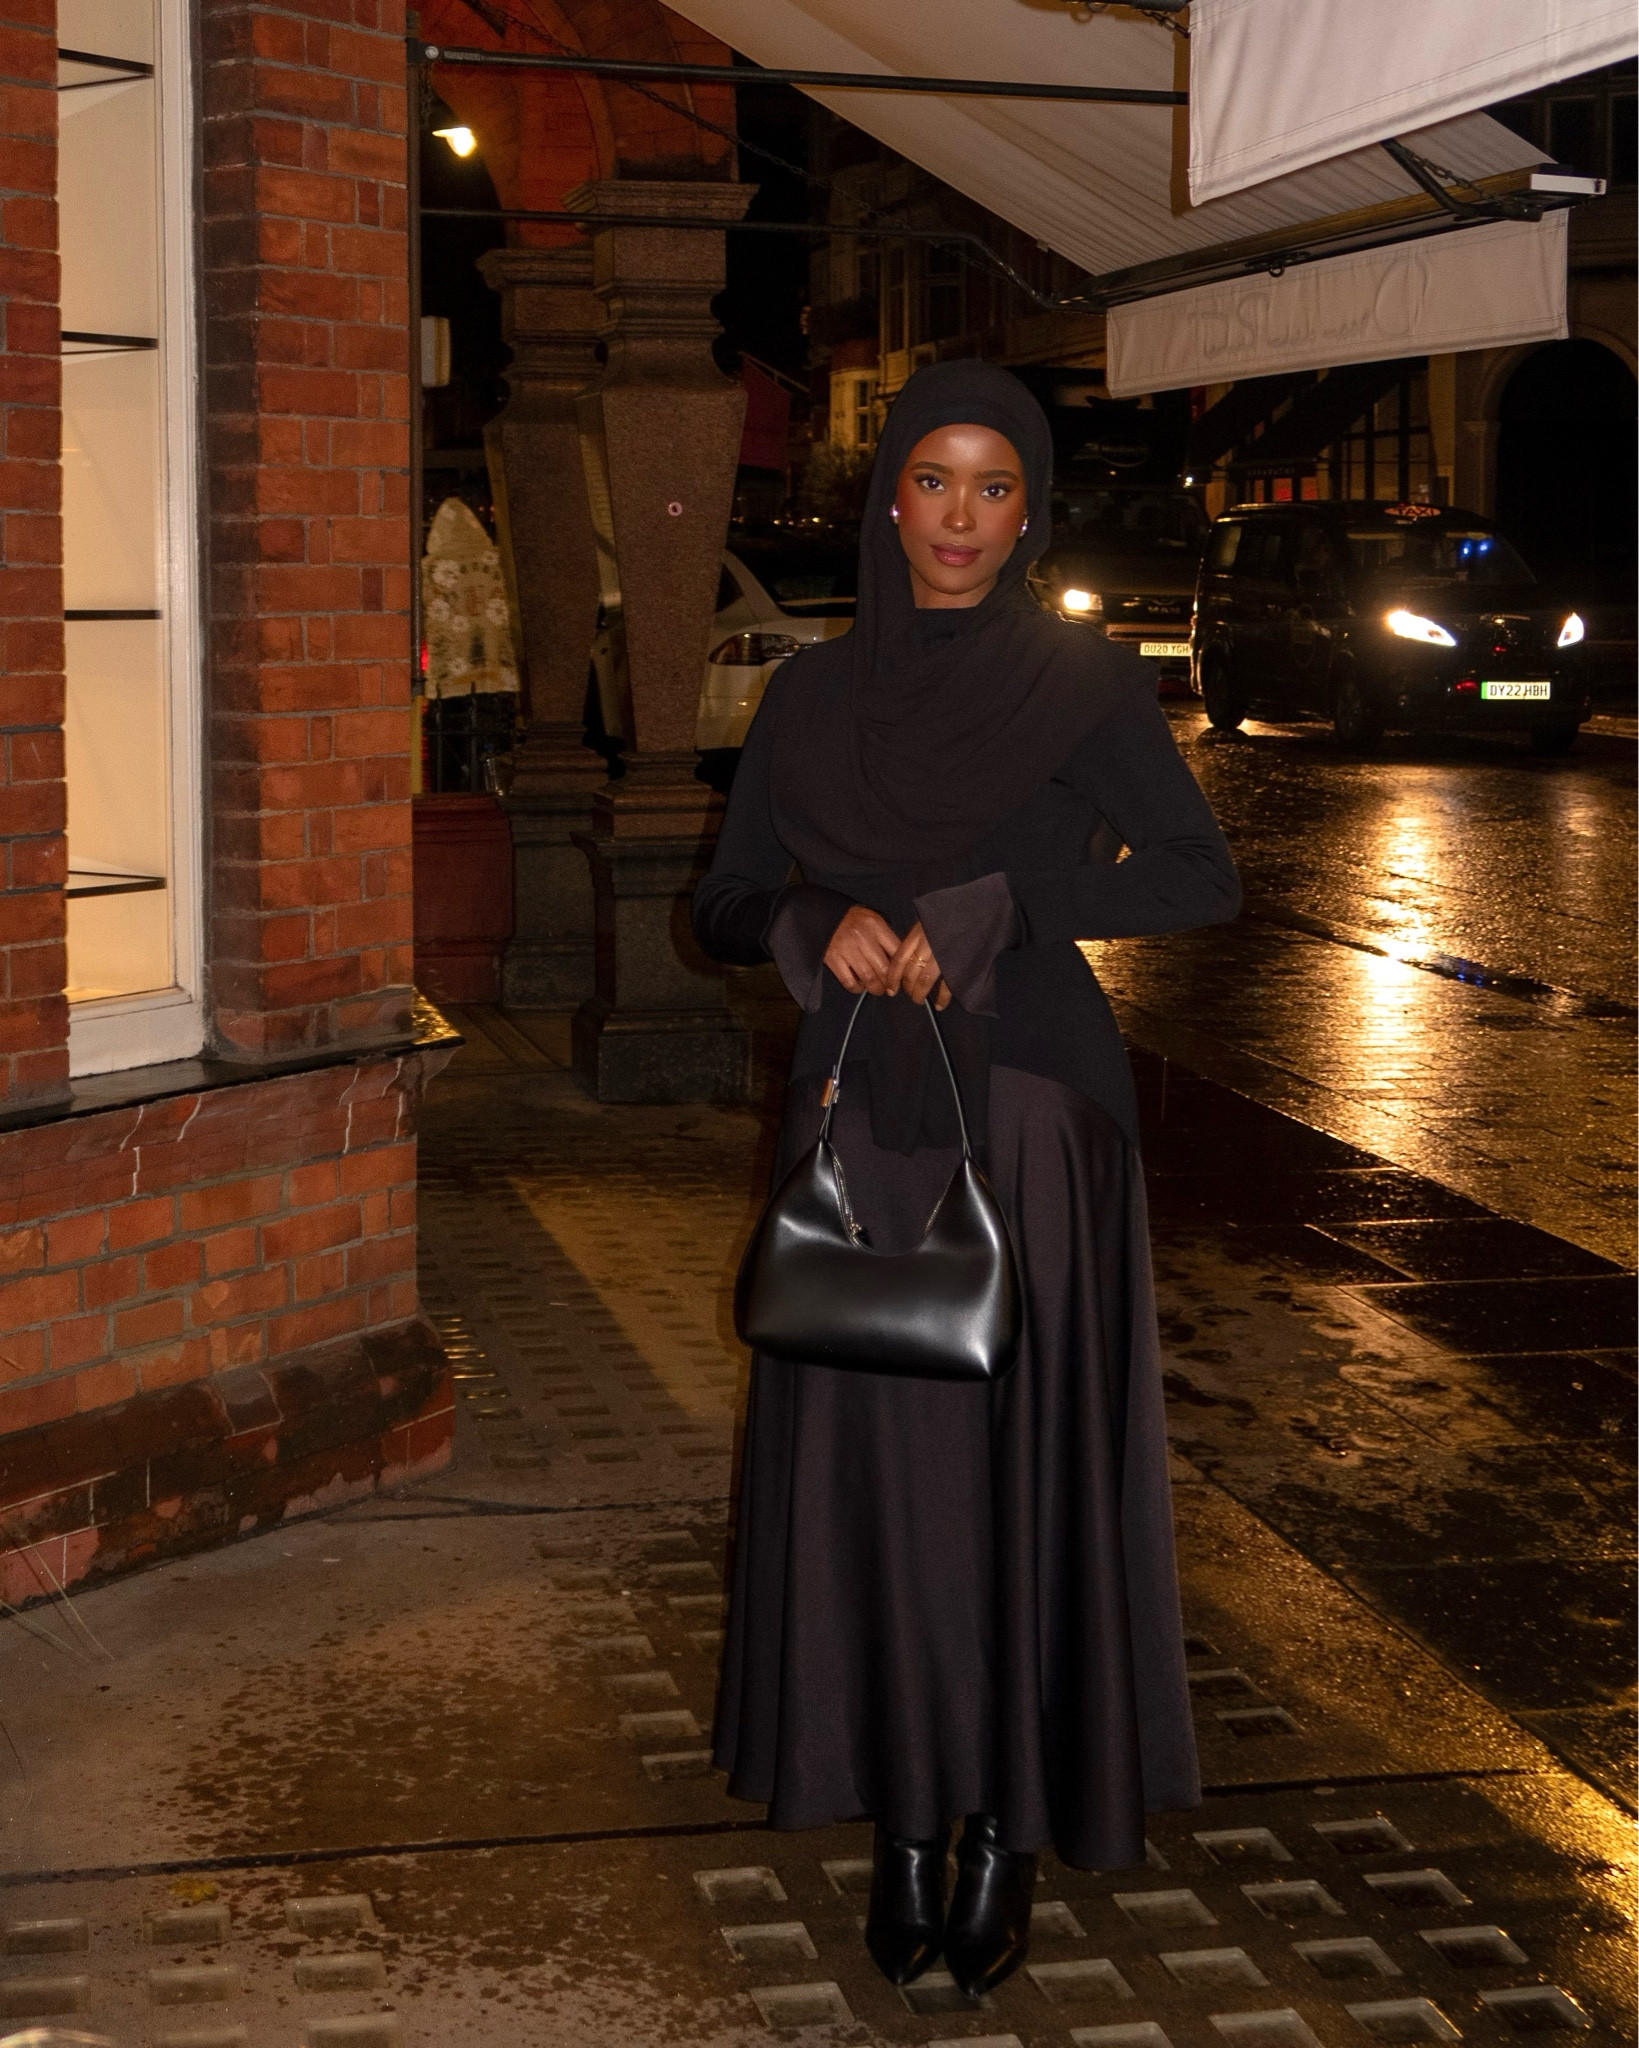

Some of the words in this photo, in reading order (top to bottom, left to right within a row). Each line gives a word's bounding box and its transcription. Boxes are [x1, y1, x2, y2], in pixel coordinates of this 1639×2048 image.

[1394, 507, 1434, 516] TAXI
[1144, 644, 1168, 654] OU20
[1490, 685, 1521, 696] DY22
[1525, 685, 1547, 696] HBH
